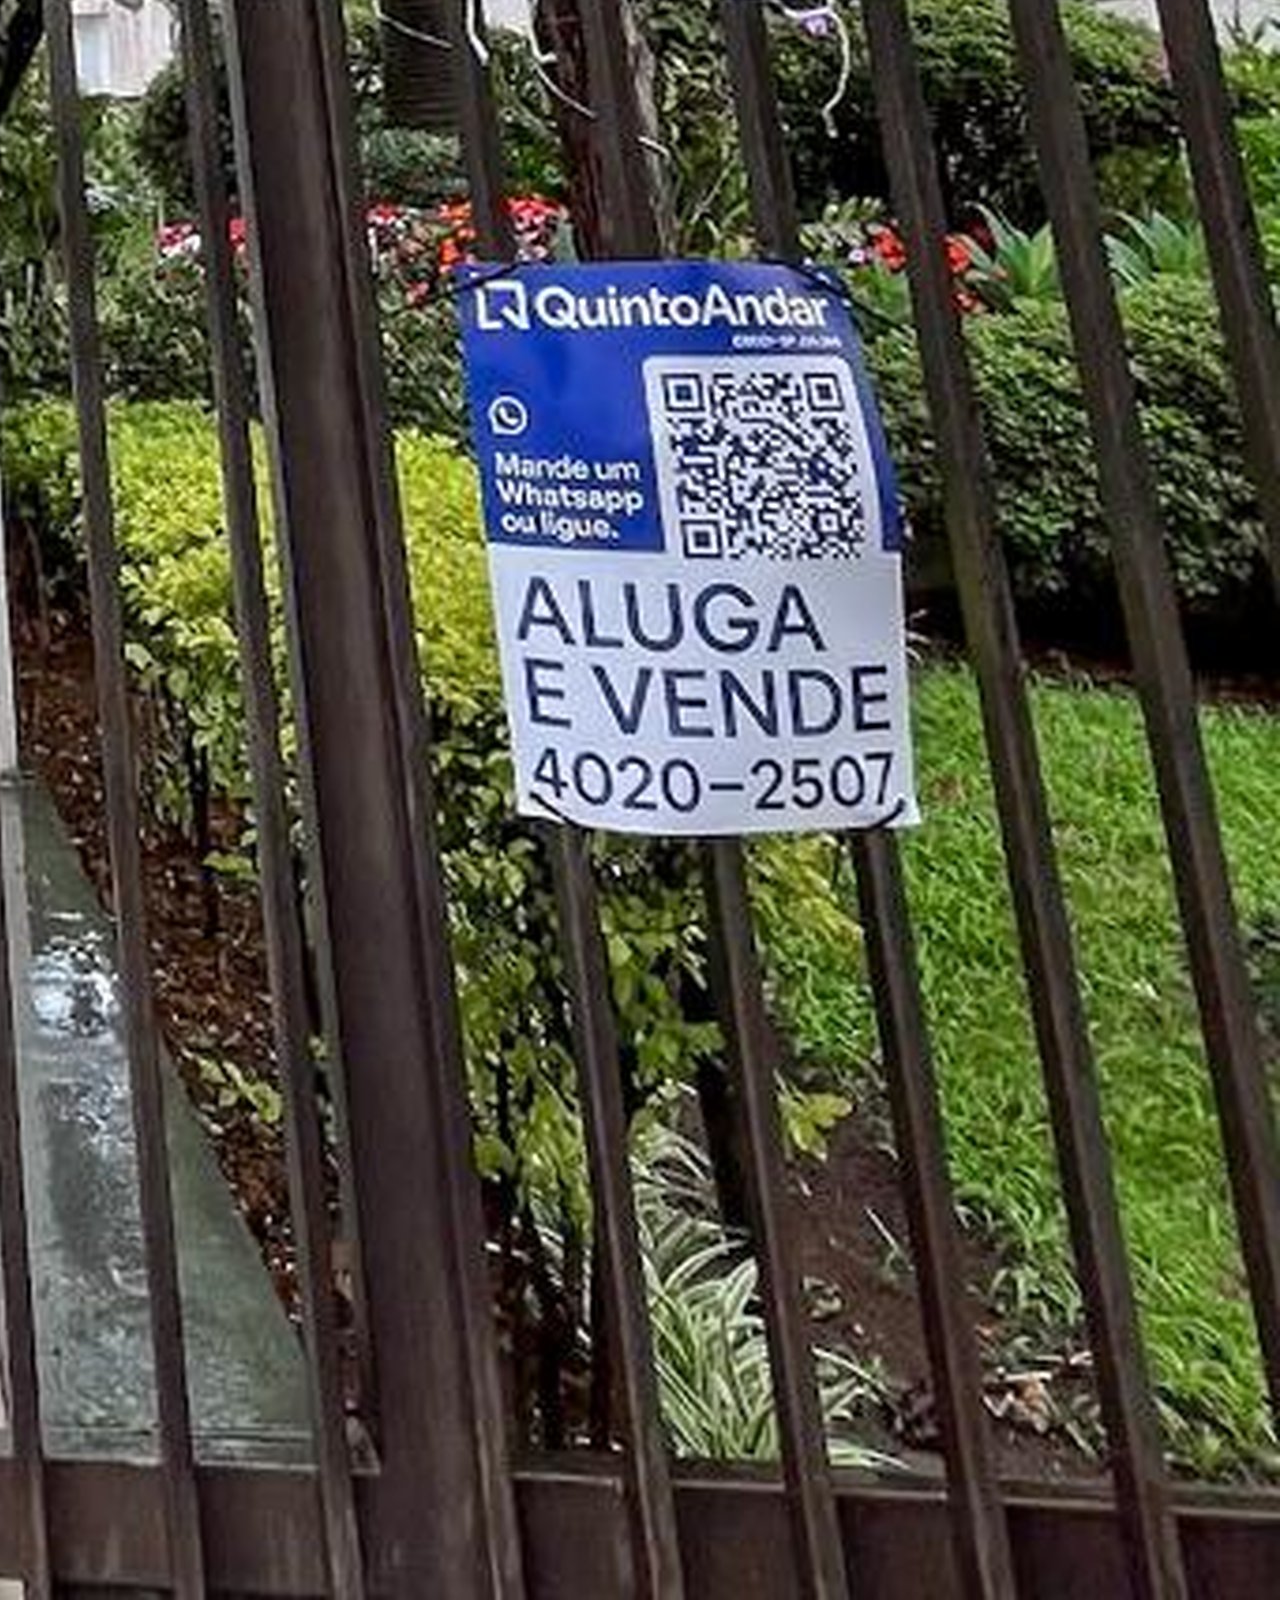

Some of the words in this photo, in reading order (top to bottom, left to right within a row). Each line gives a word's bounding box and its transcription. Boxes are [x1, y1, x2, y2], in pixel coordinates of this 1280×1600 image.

[535, 283, 828, 329] QuintoAndar
[494, 451, 589, 480] Mande
[593, 461, 640, 481] um
[495, 479, 645, 517] Whatsapp
[501, 512, 537, 534] ou
[540, 510, 620, 544] ligue.
[515, 574, 829, 655] ALUGA
[524, 657, 573, 730] E
[591, 663, 893, 740] VENDE
[530, 746, 897, 814] 4020-2507
